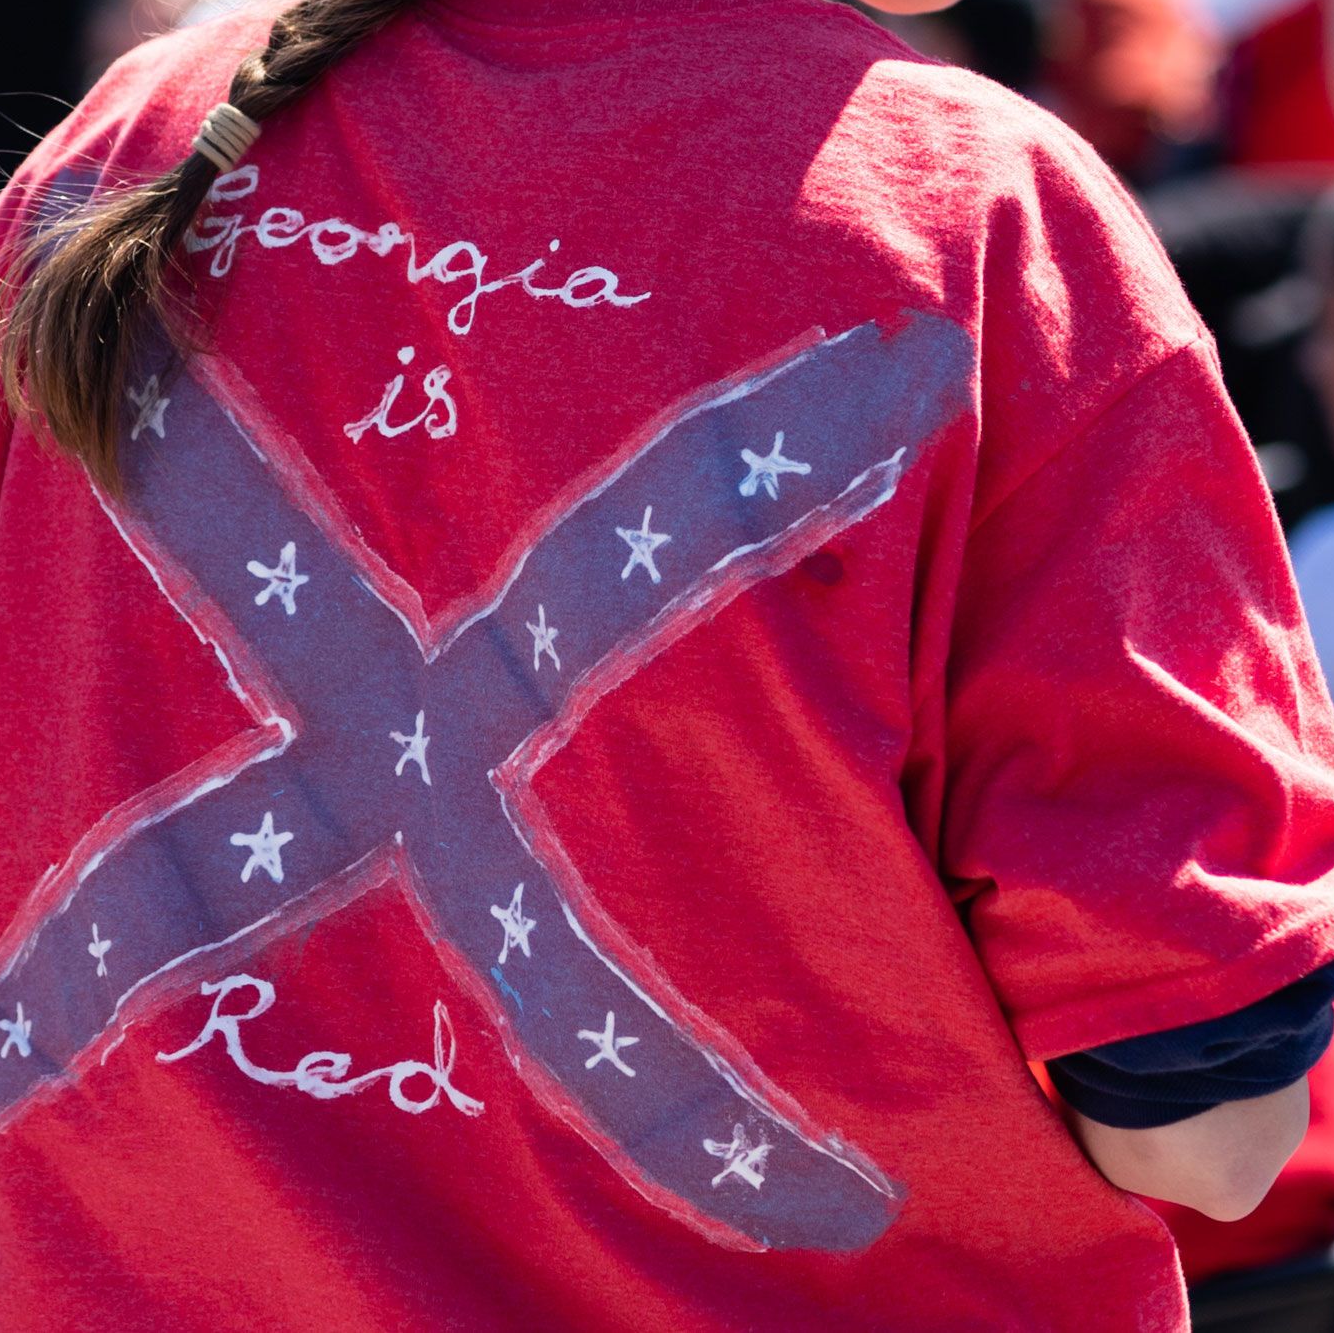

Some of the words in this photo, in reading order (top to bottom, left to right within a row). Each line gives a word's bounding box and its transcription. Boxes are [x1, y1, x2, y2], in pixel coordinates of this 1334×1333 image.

[184, 164, 651, 335] Georgia
[344, 346, 457, 445] is
[155, 973, 486, 1117] Red
